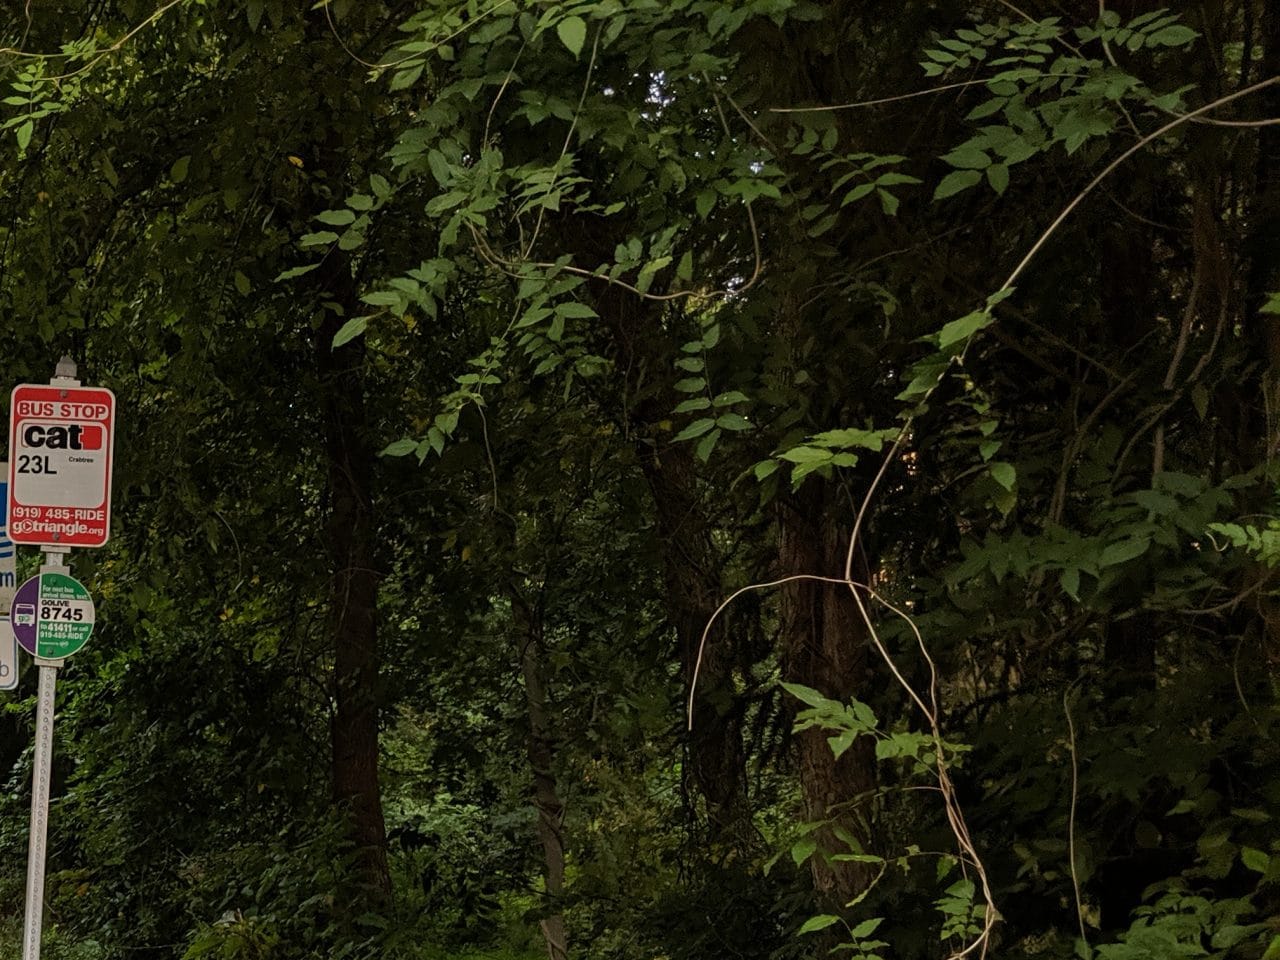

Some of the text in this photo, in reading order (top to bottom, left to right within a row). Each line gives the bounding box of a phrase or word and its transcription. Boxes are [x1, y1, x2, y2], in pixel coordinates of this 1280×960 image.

[20, 402, 106, 419] BUS STOP
[24, 424, 82, 450] cat
[17, 455, 57, 475] 23L
[12, 507, 105, 521] (919) 485-RIDE
[41, 599, 70, 607] GOLIVE
[40, 606, 83, 621] 8745
[48, 623, 72, 633] 41411
